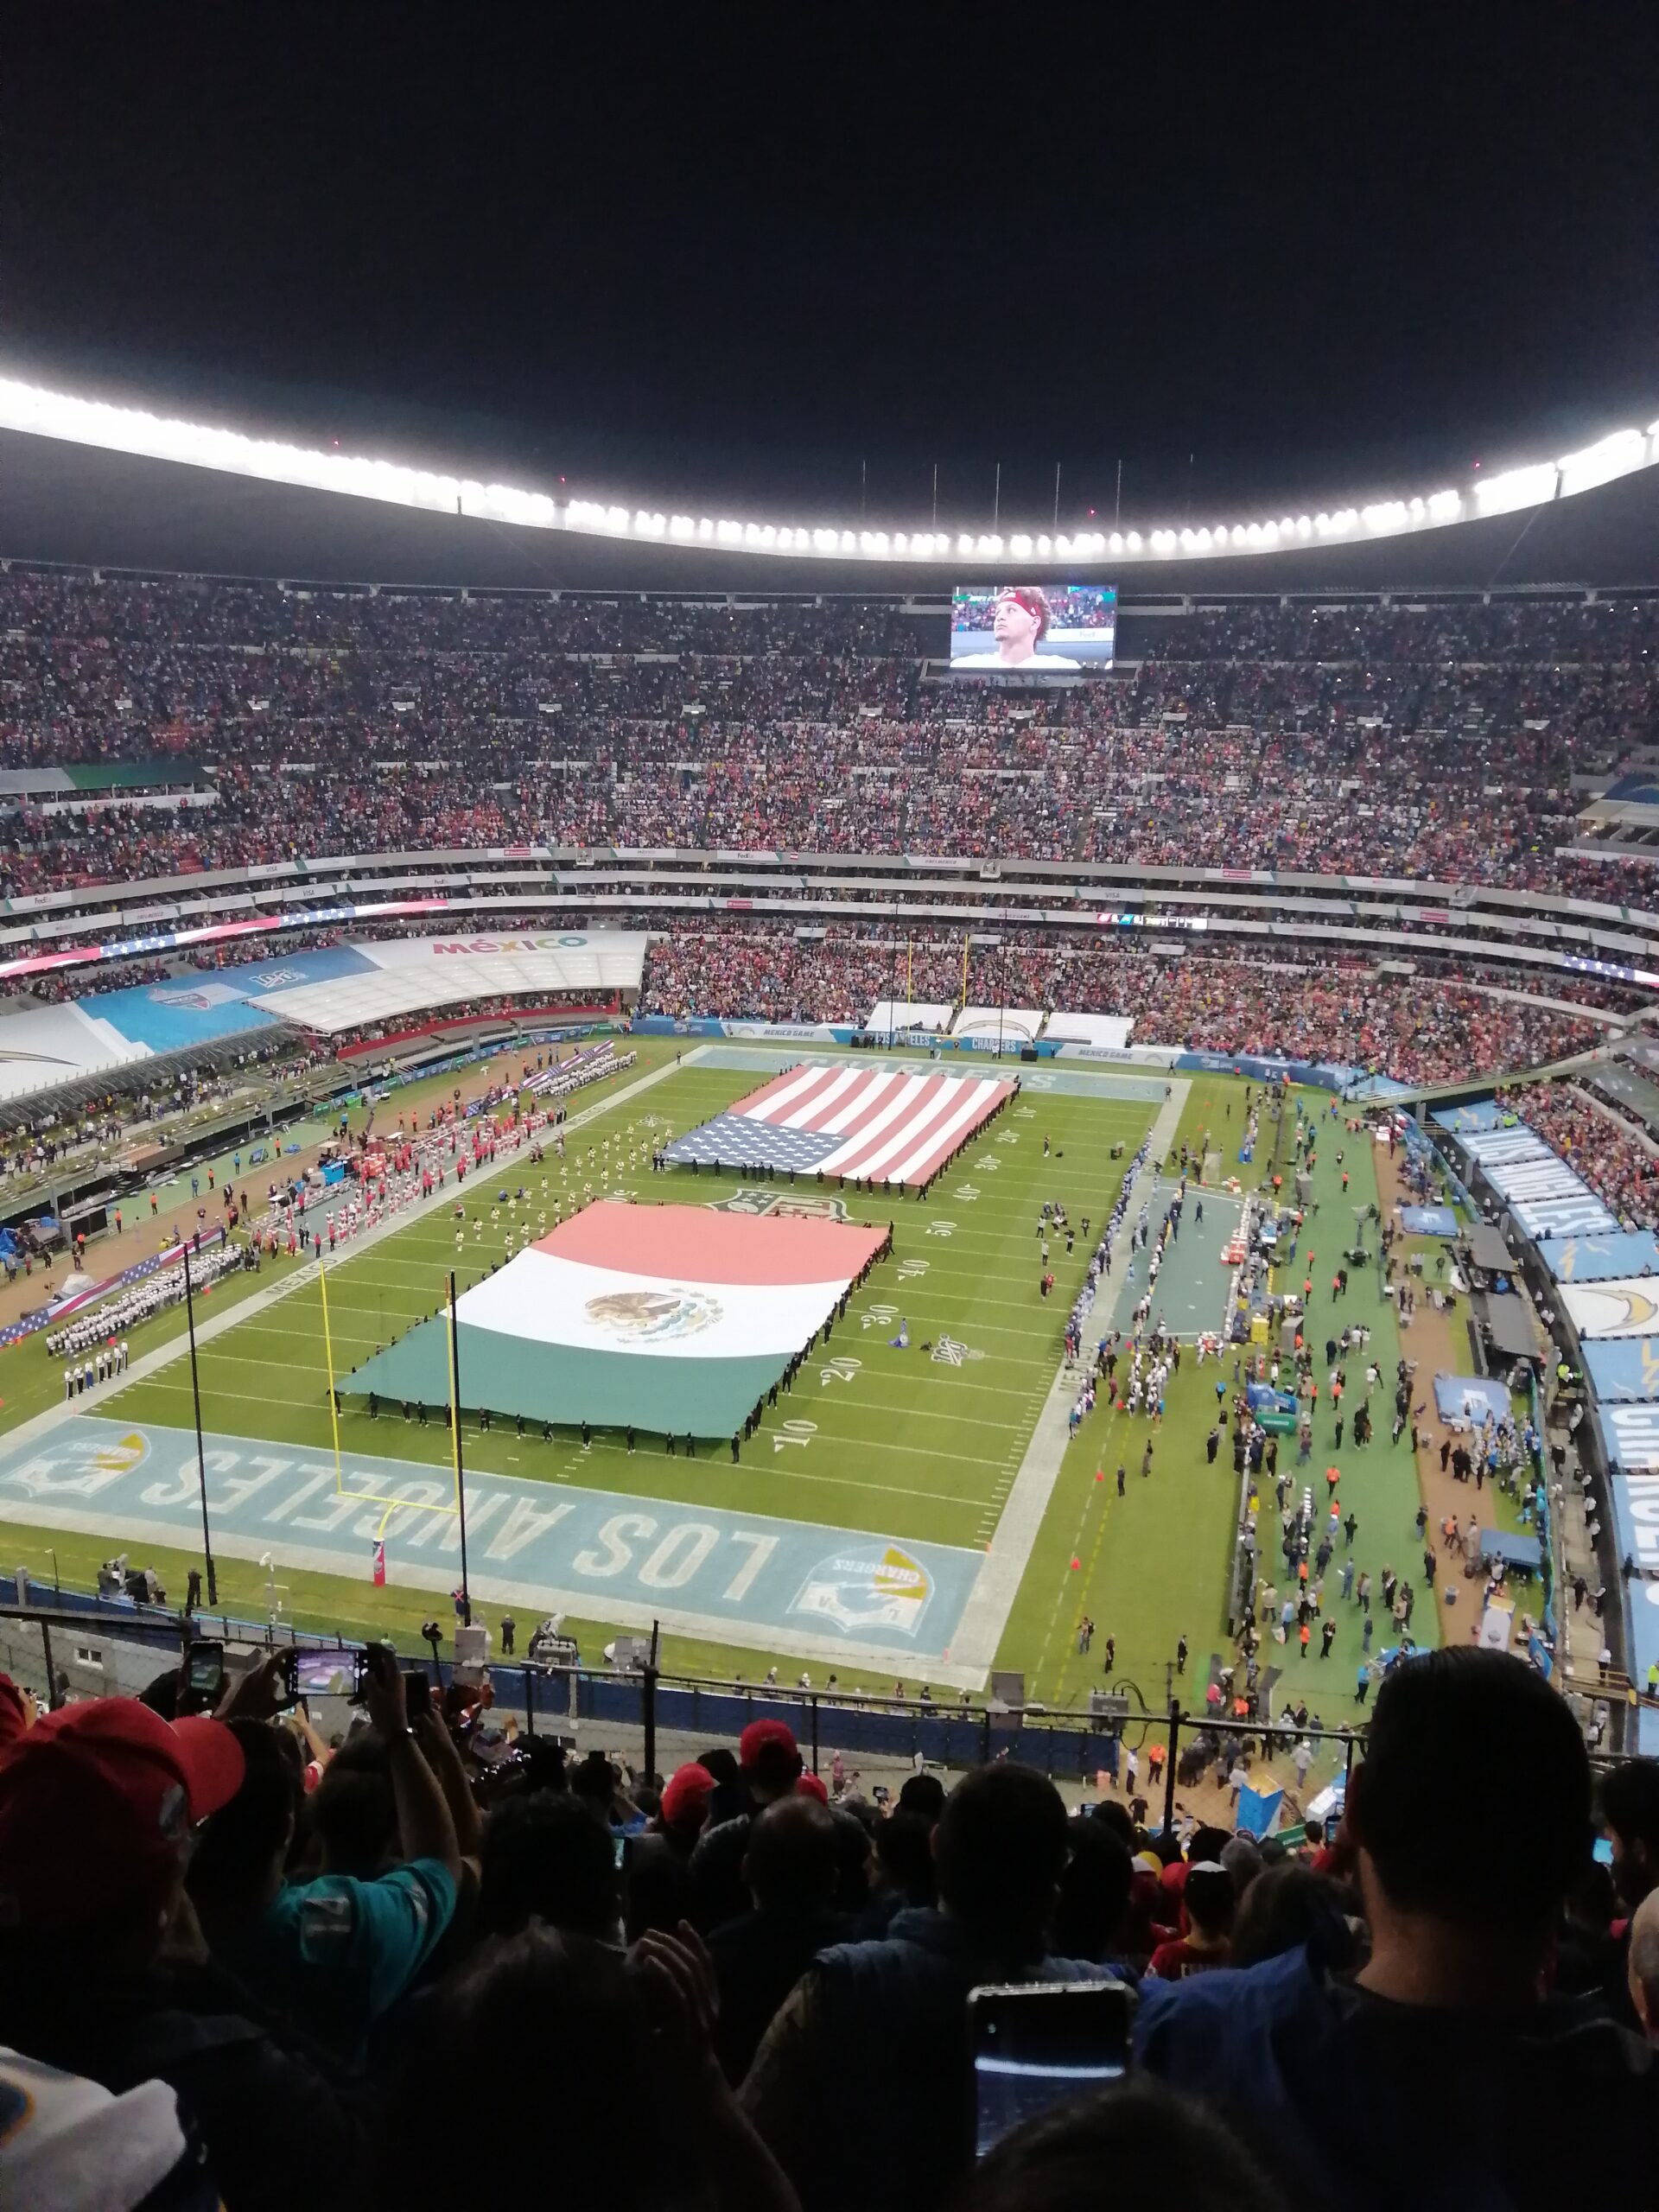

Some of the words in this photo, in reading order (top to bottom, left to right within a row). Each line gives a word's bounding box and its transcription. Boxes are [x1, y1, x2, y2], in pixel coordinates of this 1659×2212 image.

[1013, 1109, 1037, 1118] 10
[995, 1132, 1020, 1143] 20
[1462, 1129, 1548, 1161] LOS
[975, 1157, 1001, 1170] 30
[952, 1187, 981, 1201] 40
[925, 1221, 957, 1236] 50
[897, 1259, 931, 1276] 40
[861, 1304, 899, 1325] 30
[820, 1357, 862, 1382] 20
[772, 1419, 818, 1446] 10
[140, 1450, 577, 1561] ANGELES
[572, 1514, 780, 1602] LOS
[832, 1559, 921, 1584] CHARGERS
